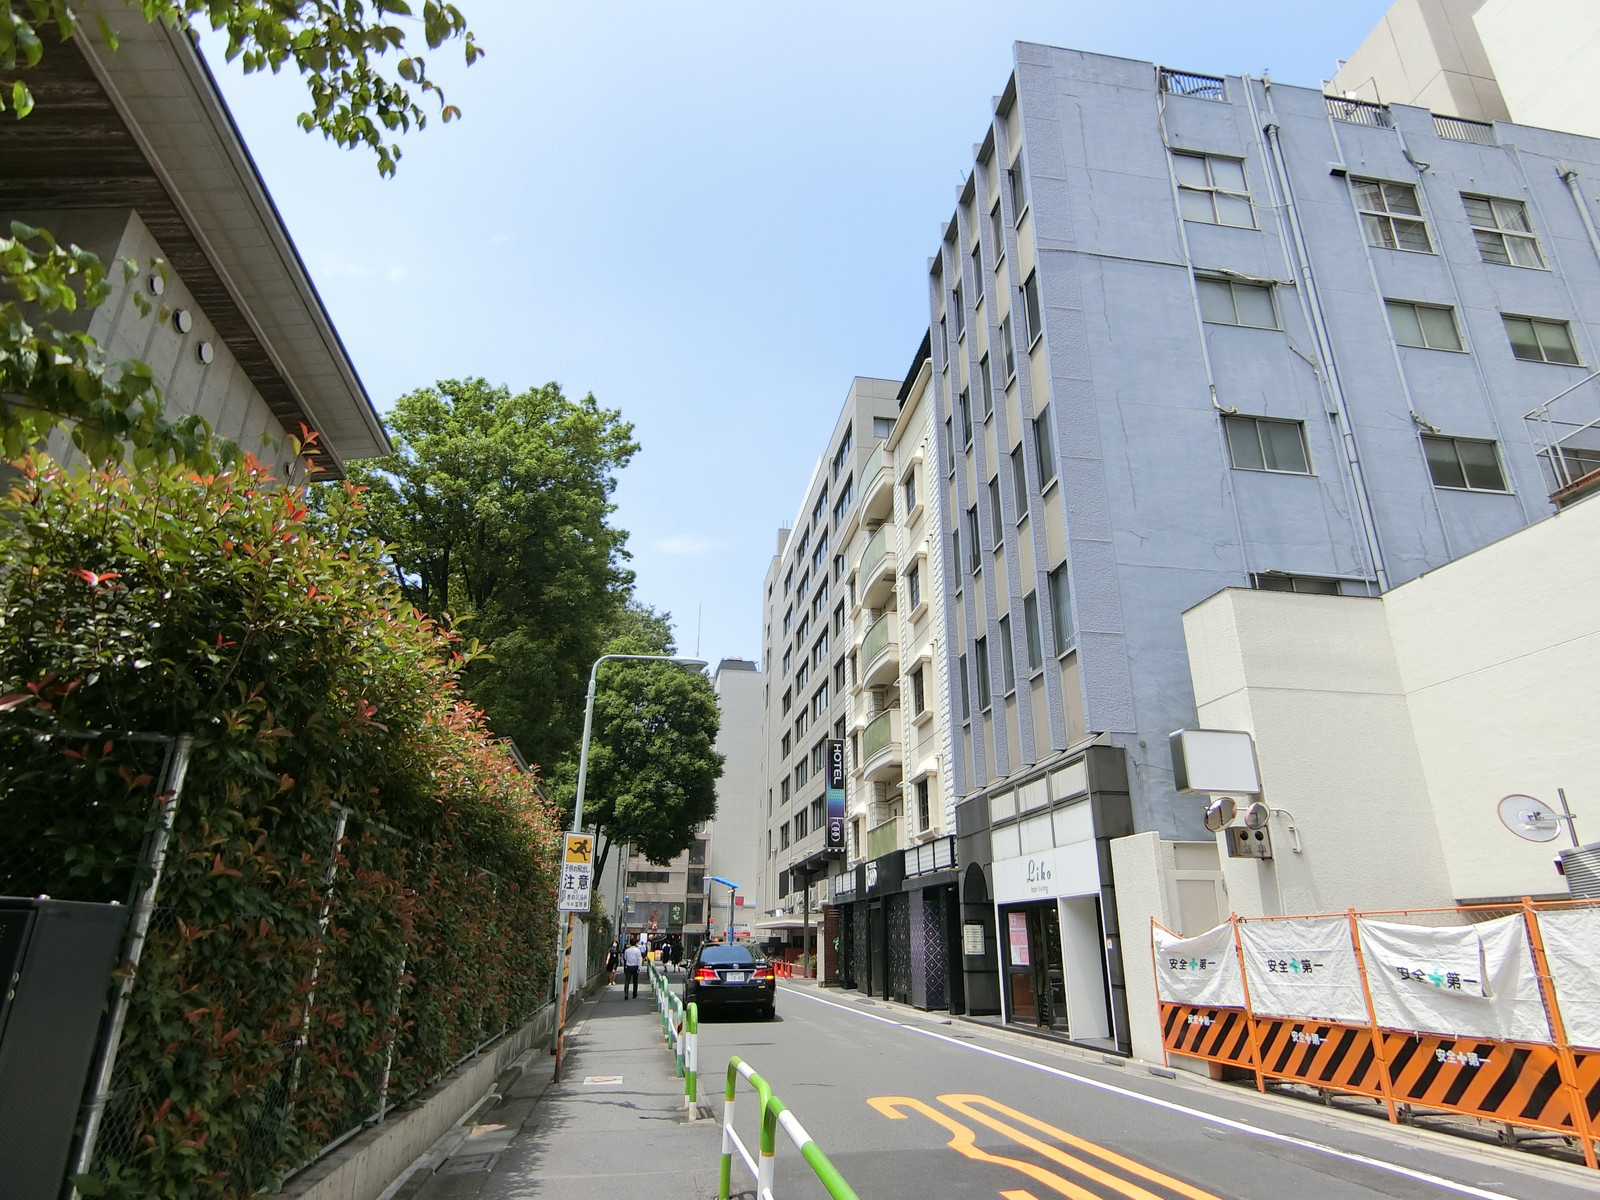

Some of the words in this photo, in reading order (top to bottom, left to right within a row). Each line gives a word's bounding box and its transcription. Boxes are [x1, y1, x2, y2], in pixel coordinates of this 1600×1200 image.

[833, 743, 842, 785] HOTEL
[563, 874, 589, 889] 注意
[1026, 859, 1051, 883] Liko
